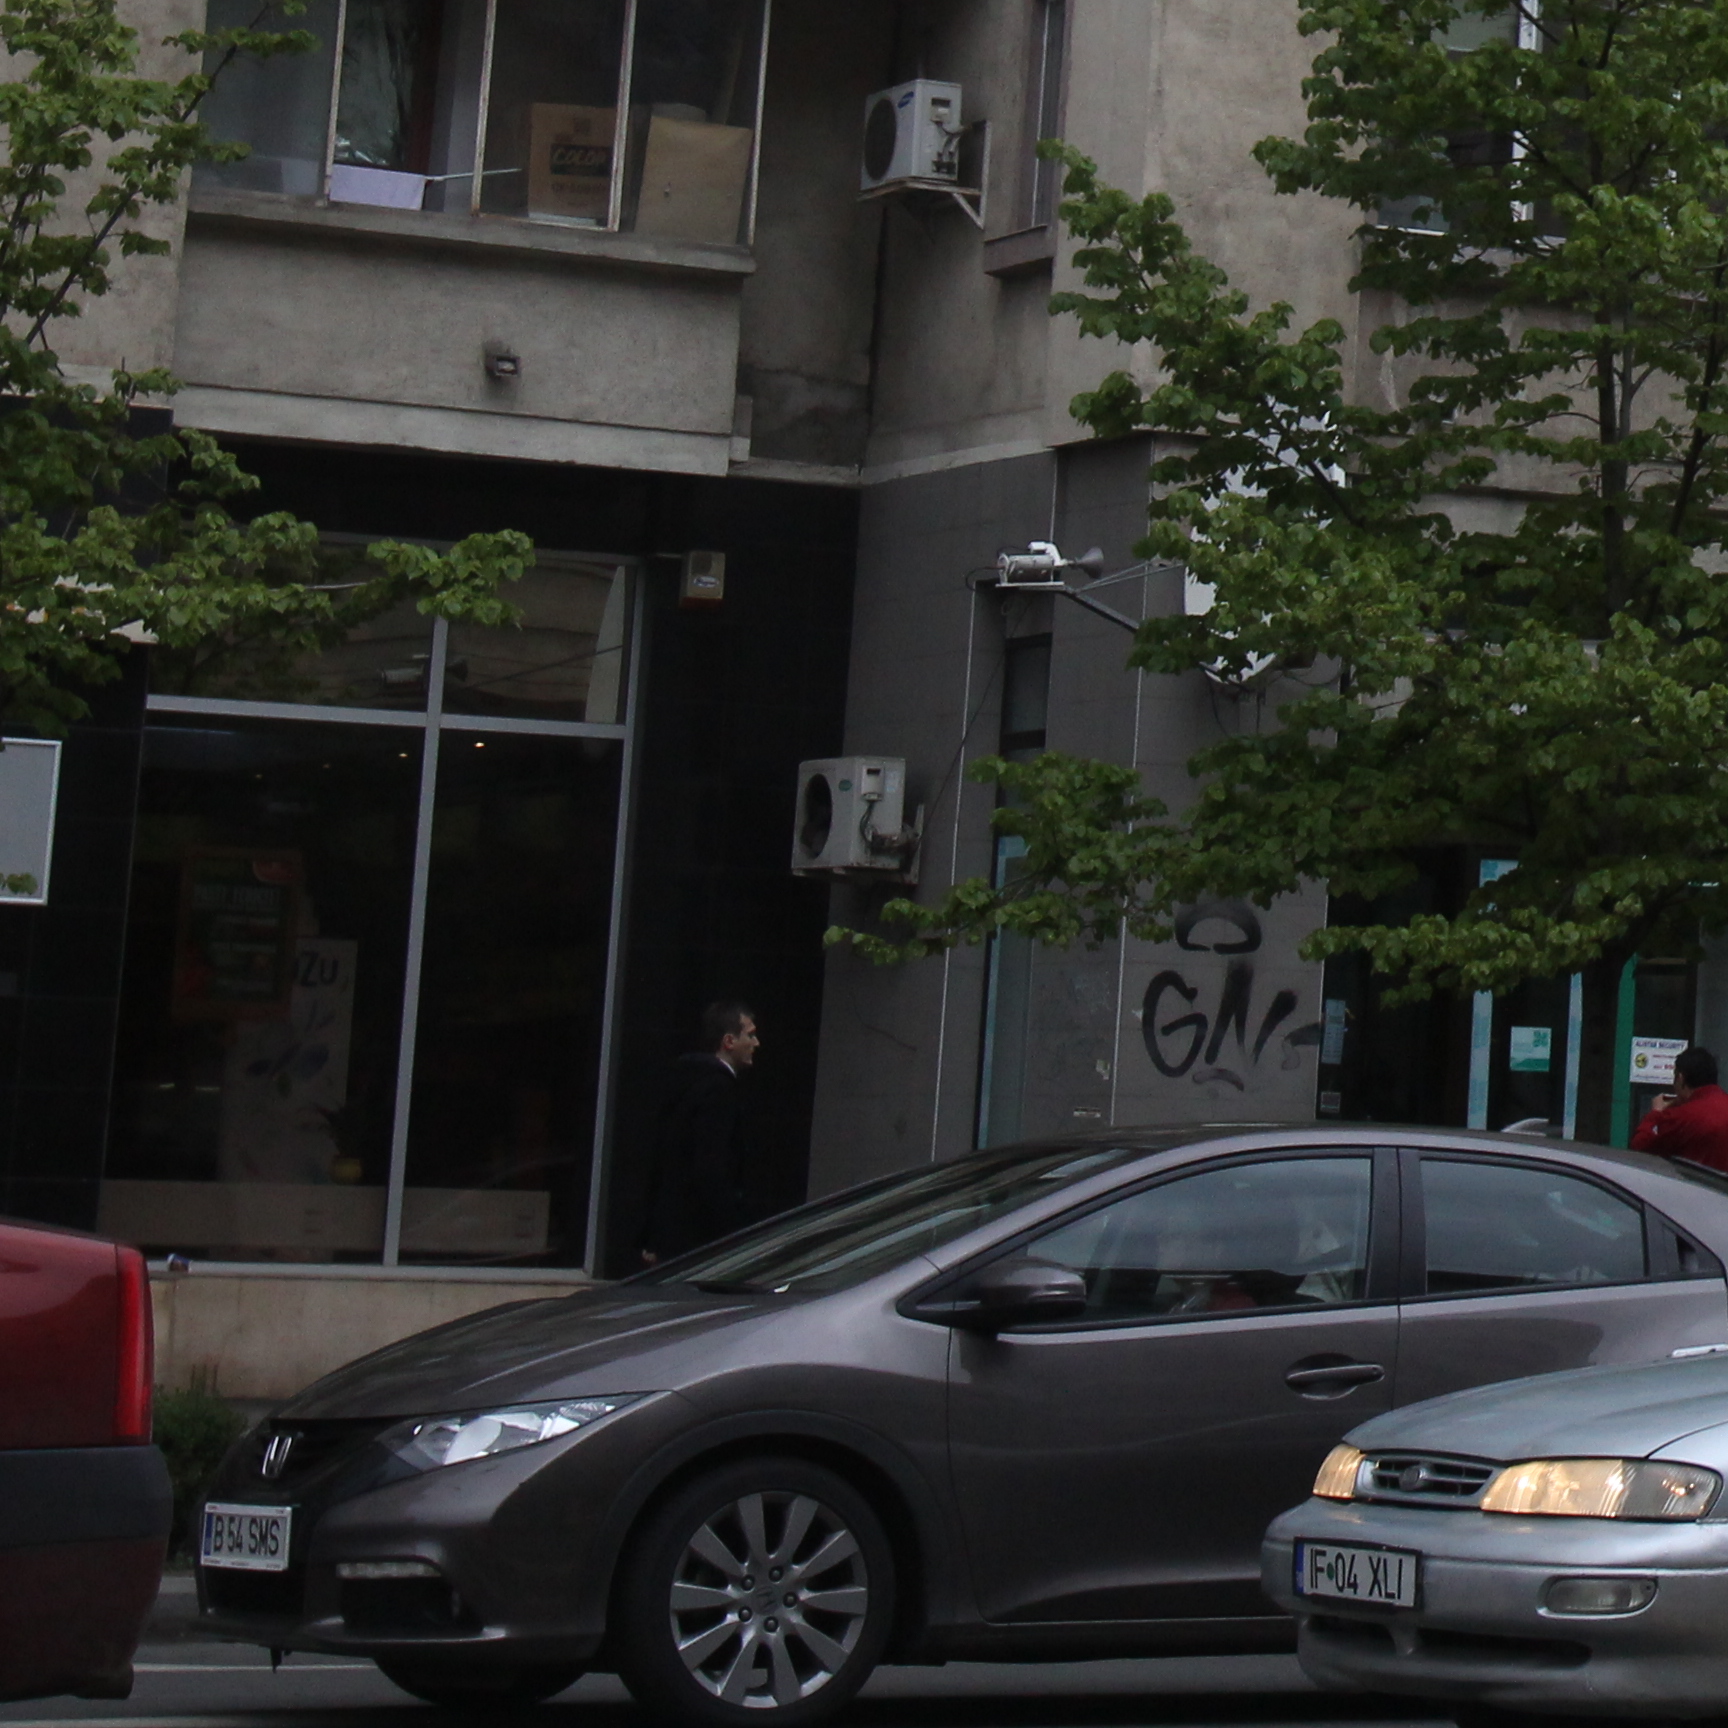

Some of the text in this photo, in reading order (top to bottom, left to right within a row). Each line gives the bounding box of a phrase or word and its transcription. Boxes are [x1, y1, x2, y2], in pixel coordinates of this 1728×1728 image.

[213, 1515, 280, 1557] B 54 SMS
[1310, 1547, 1403, 1600] IF 04 XLI
